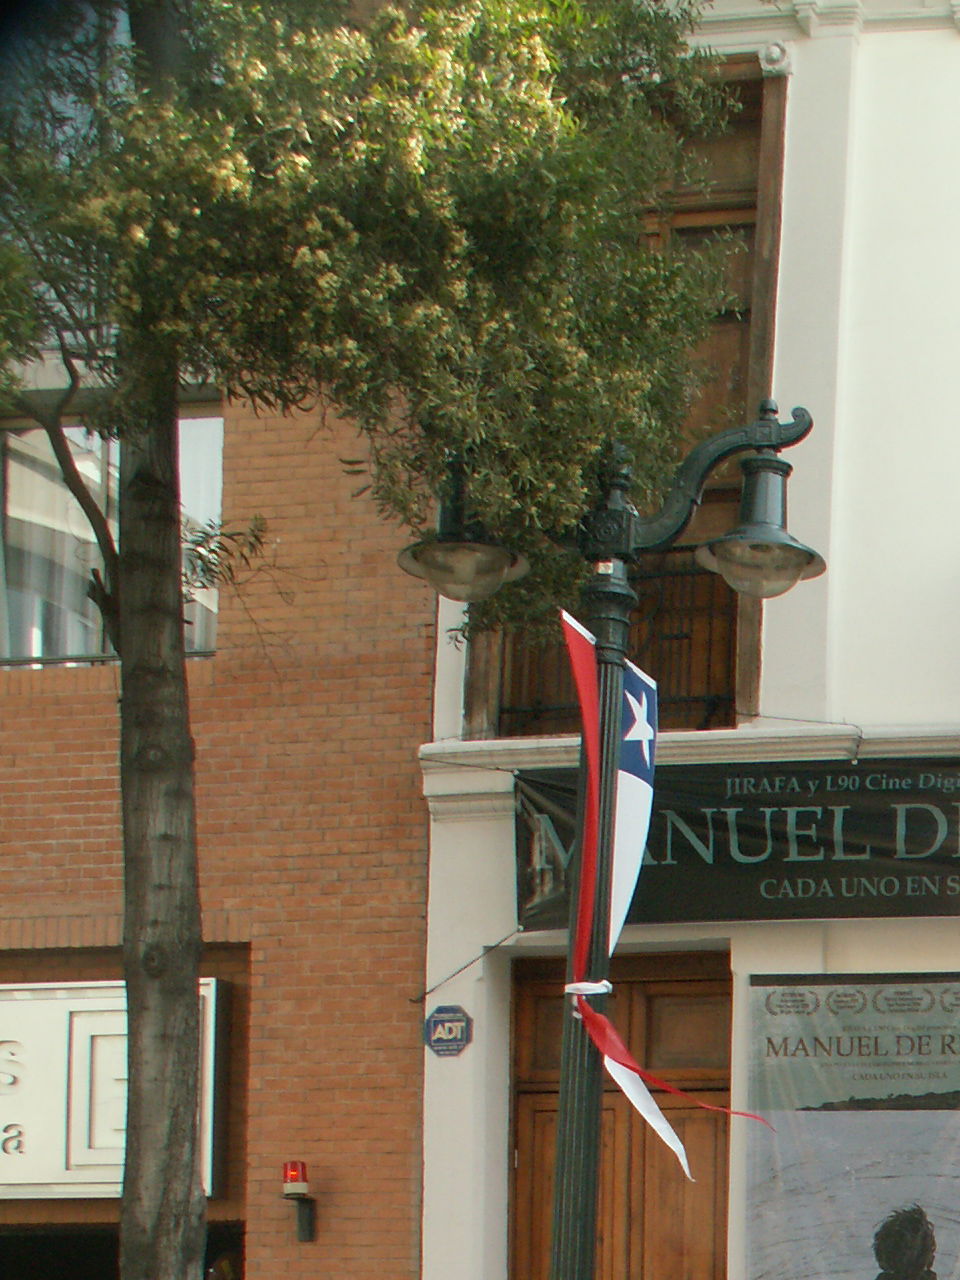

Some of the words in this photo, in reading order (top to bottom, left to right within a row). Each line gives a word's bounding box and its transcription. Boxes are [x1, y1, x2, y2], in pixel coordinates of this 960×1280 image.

[725, 776, 801, 799] JIRAFA
[808, 779, 820, 798] y
[826, 775, 860, 793] L90
[865, 773, 912, 791] Cine
[528, 805, 871, 871] MNUEL
[760, 878, 835, 900] CADA
[841, 876, 900, 898] UNO
[906, 875, 940, 897] EN
[431, 1021, 466, 1041] ADT
[765, 1035, 889, 1058] MANUEL
[895, 1033, 933, 1056] DE
